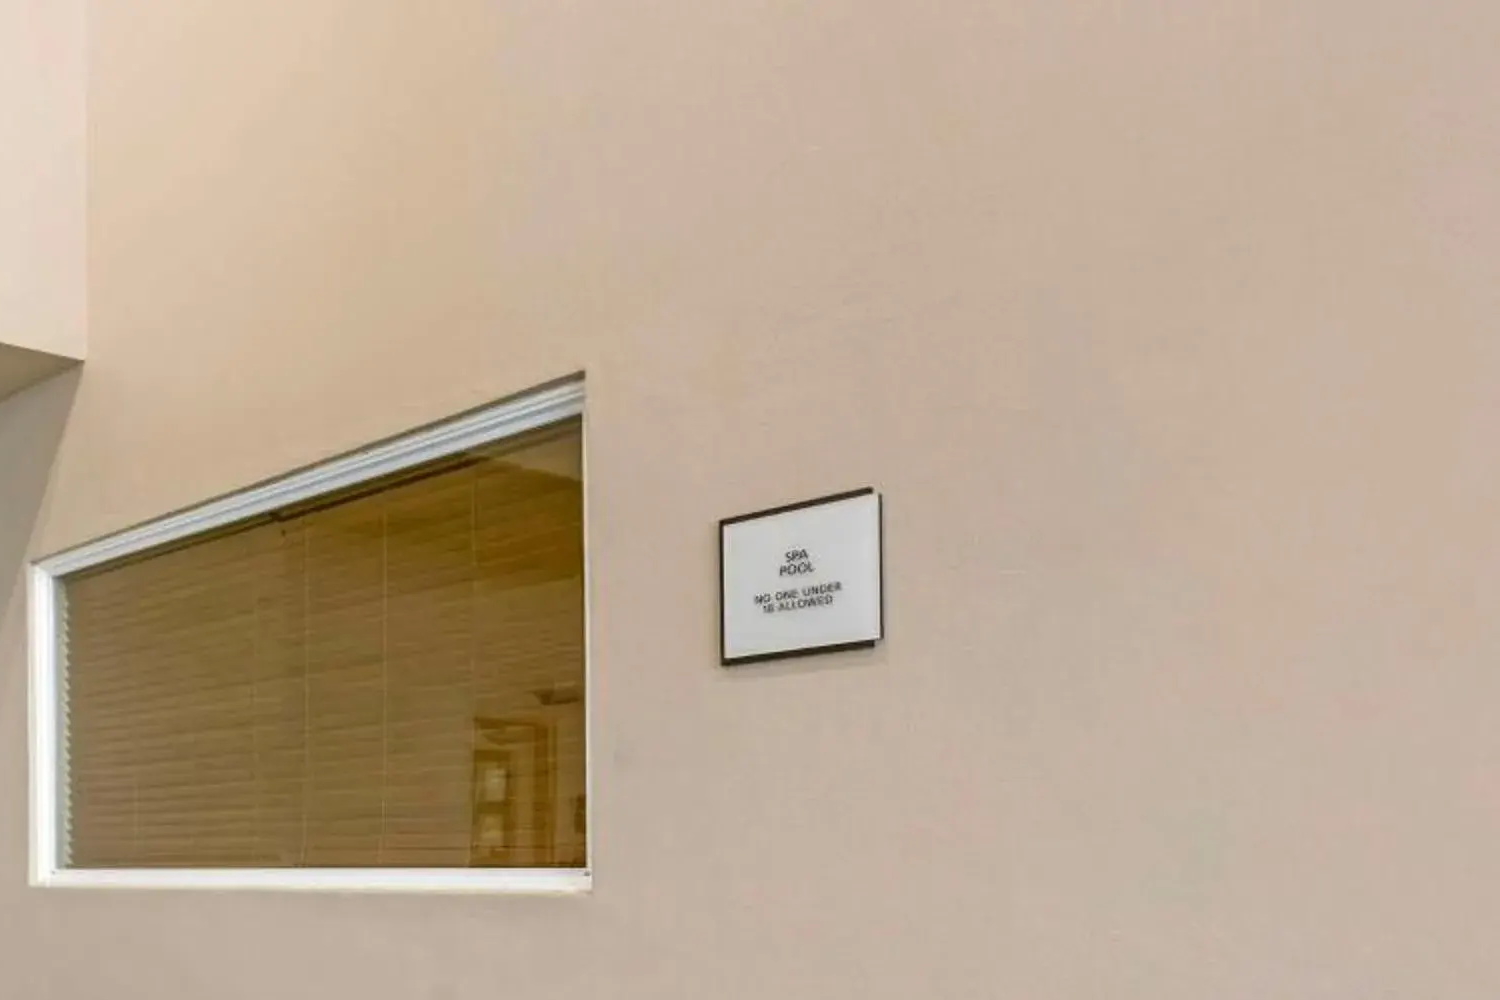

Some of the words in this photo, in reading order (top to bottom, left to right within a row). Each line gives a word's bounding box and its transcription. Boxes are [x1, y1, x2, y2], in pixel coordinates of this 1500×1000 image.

[785, 549, 808, 563] SPA
[779, 561, 815, 576] POOL
[754, 593, 771, 605] NO
[775, 589, 799, 601] ONE
[802, 582, 842, 597] UNDER
[778, 594, 833, 611] ALLOWED
